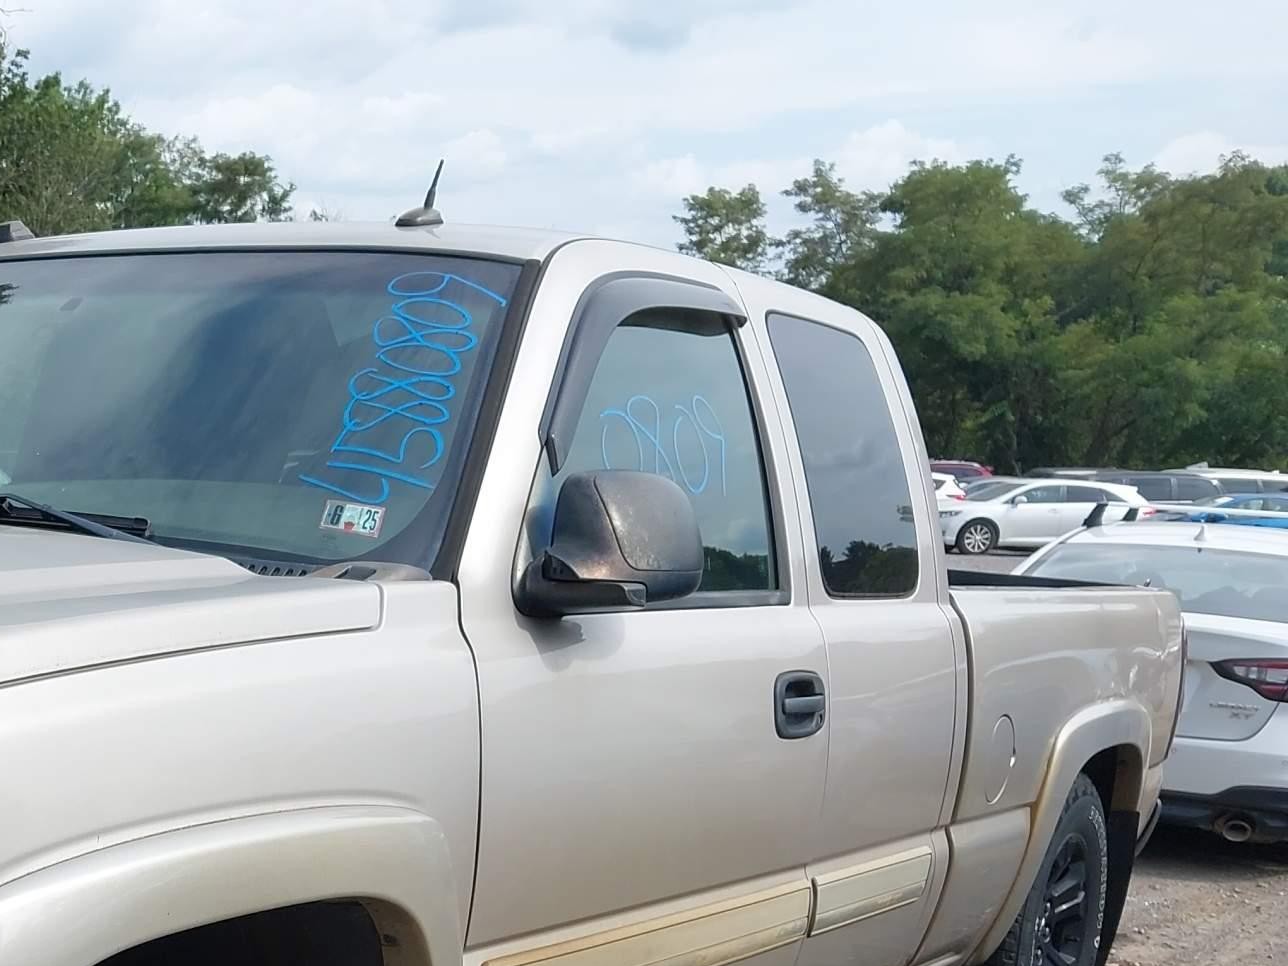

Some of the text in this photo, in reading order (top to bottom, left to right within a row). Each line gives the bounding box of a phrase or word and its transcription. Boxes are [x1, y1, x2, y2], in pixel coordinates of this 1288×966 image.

[299, 271, 508, 505] 45880809
[600, 395, 727, 497] 0809
[362, 509, 379, 531] 25
